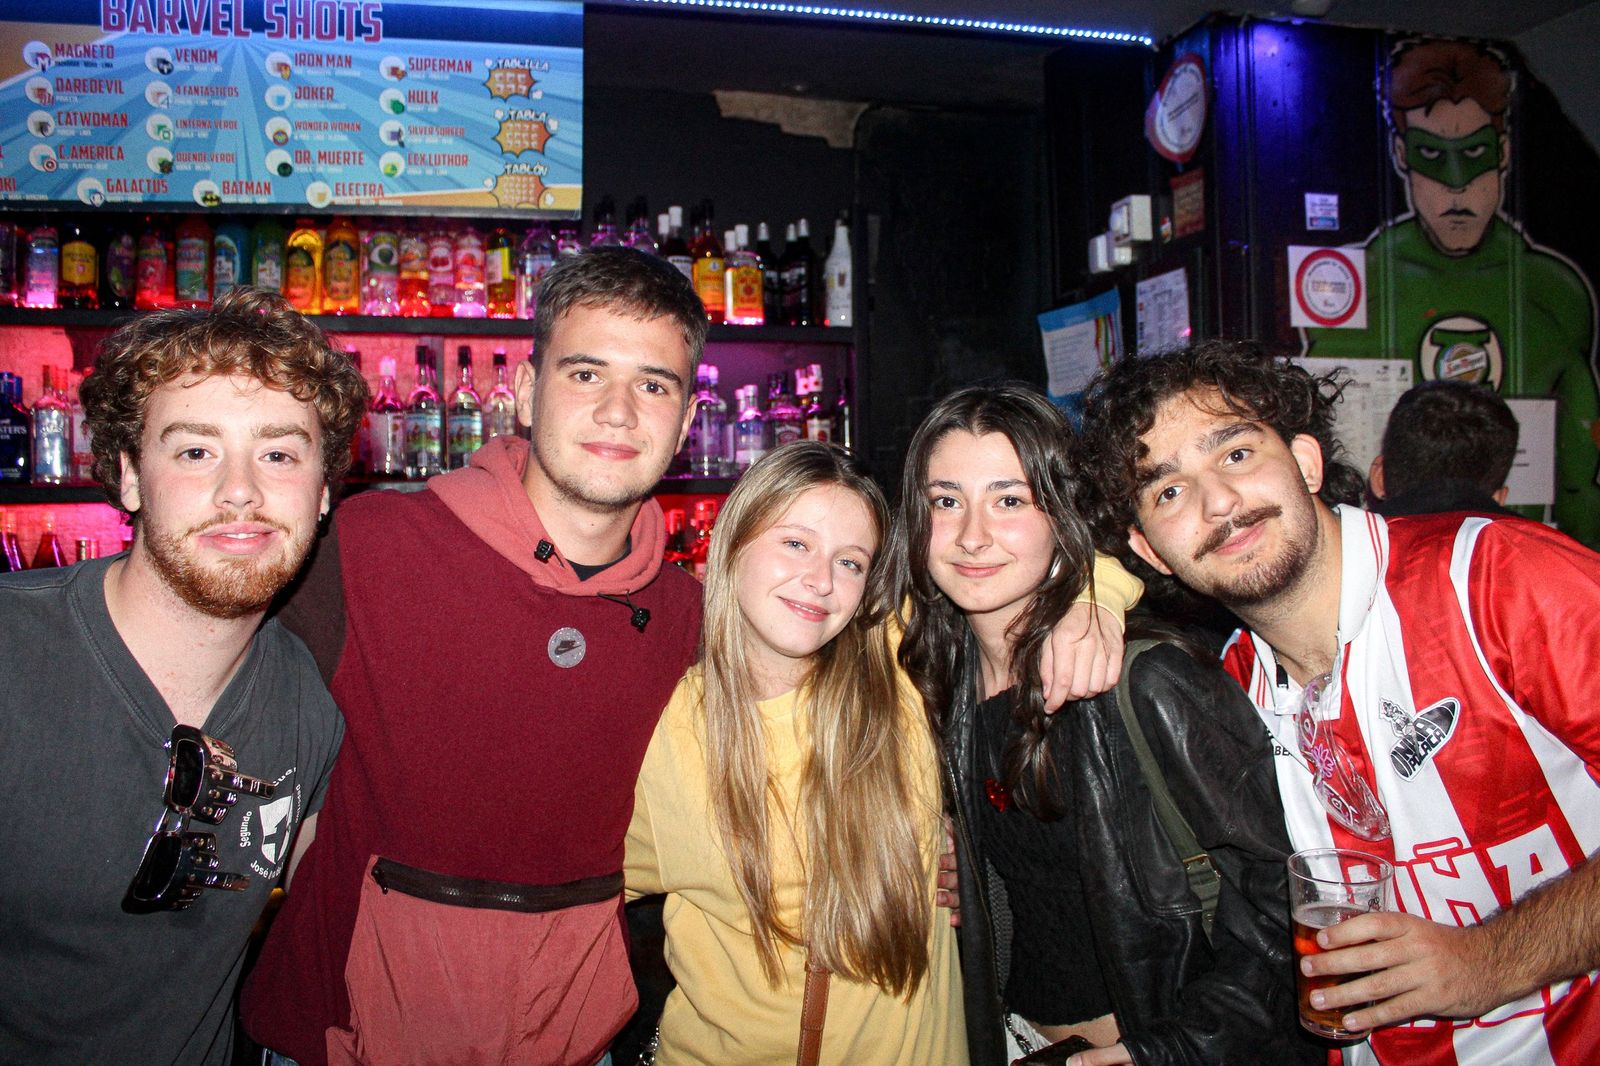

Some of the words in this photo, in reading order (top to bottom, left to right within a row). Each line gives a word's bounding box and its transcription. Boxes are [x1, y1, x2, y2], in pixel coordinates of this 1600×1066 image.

[101, 0, 251, 38] BARVEL
[264, 0, 383, 43] SHOTS
[55, 43, 115, 60] MAGNETO
[175, 48, 218, 64] VENOM
[294, 52, 323, 67] IRON
[326, 53, 353, 69] MAN
[408, 56, 473, 74] SUPERMAN
[55, 77, 125, 95] DAREDEVIL
[294, 85, 335, 101] JOKER
[408, 89, 439, 105] HULK
[57, 111, 129, 128] CATWOMAN
[509, 109, 547, 122] TABLA
[294, 120, 329, 132] WONDER
[330, 121, 361, 133] WOMAN
[294, 149, 314, 165] DR.
[317, 150, 365, 166] MUERTE
[407, 152, 426, 167] LEX
[428, 153, 469, 168] LUTHOR
[106, 178, 169, 195] GALACTUS
[222, 180, 272, 196] BATMAN
[335, 182, 385, 198] ELECTRA
[240, 810, 253, 848] Segundo
[250, 860, 269, 878] José
